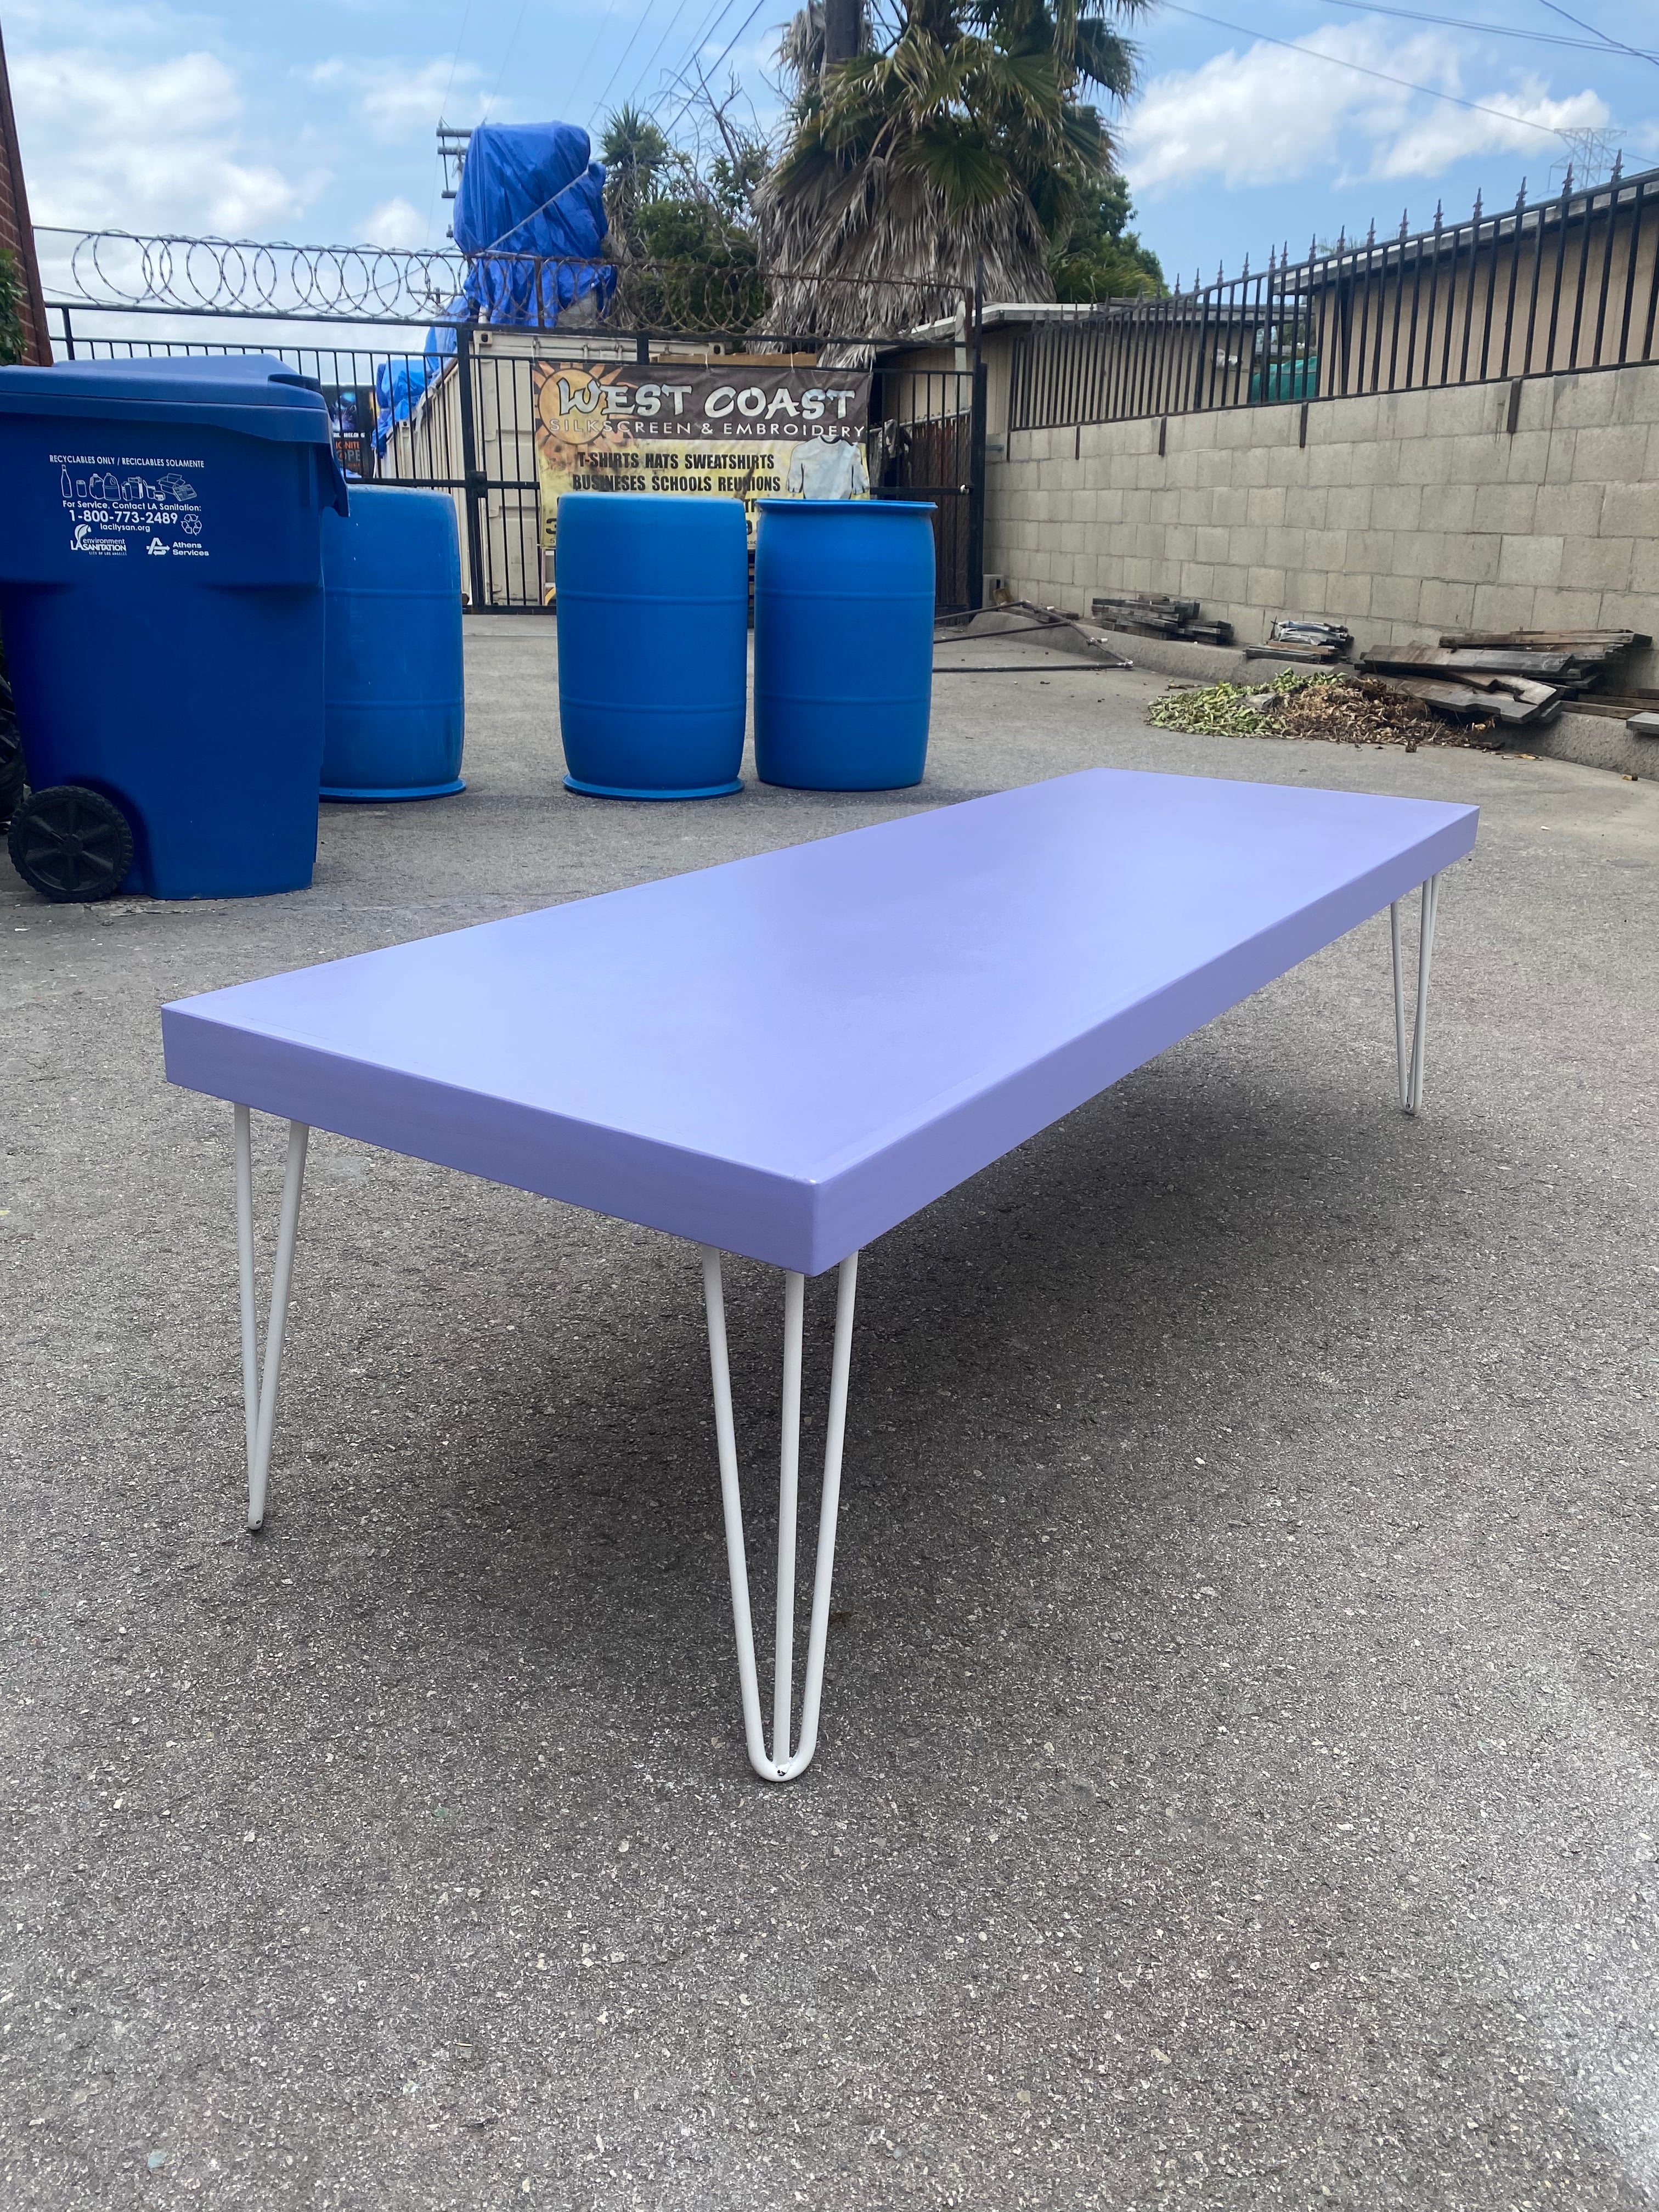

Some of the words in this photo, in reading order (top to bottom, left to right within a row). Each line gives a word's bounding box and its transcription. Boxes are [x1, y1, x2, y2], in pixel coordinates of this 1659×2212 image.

[557, 377, 692, 416] WEST
[704, 386, 855, 420] COAST
[549, 419, 691, 434] SILKSCREEN
[701, 422, 713, 435] &
[723, 422, 865, 437] EMBROIDERY
[49, 455, 95, 464] RECYCLABLES
[97, 456, 115, 465] ONLY
[122, 457, 165, 466] RECICLABLES
[166, 459, 205, 468] SOLAMENTE
[578, 452, 639, 469] T-SHIRTS
[645, 453, 679, 469] HATS
[685, 454, 775, 469] SWEATSHIRTS
[652, 476, 712, 492] SCHOOLS
[112, 502, 145, 510] Contact
[69, 510, 178, 524] 1-800-773-2489
[100, 523, 150, 533] lacitysan.org
